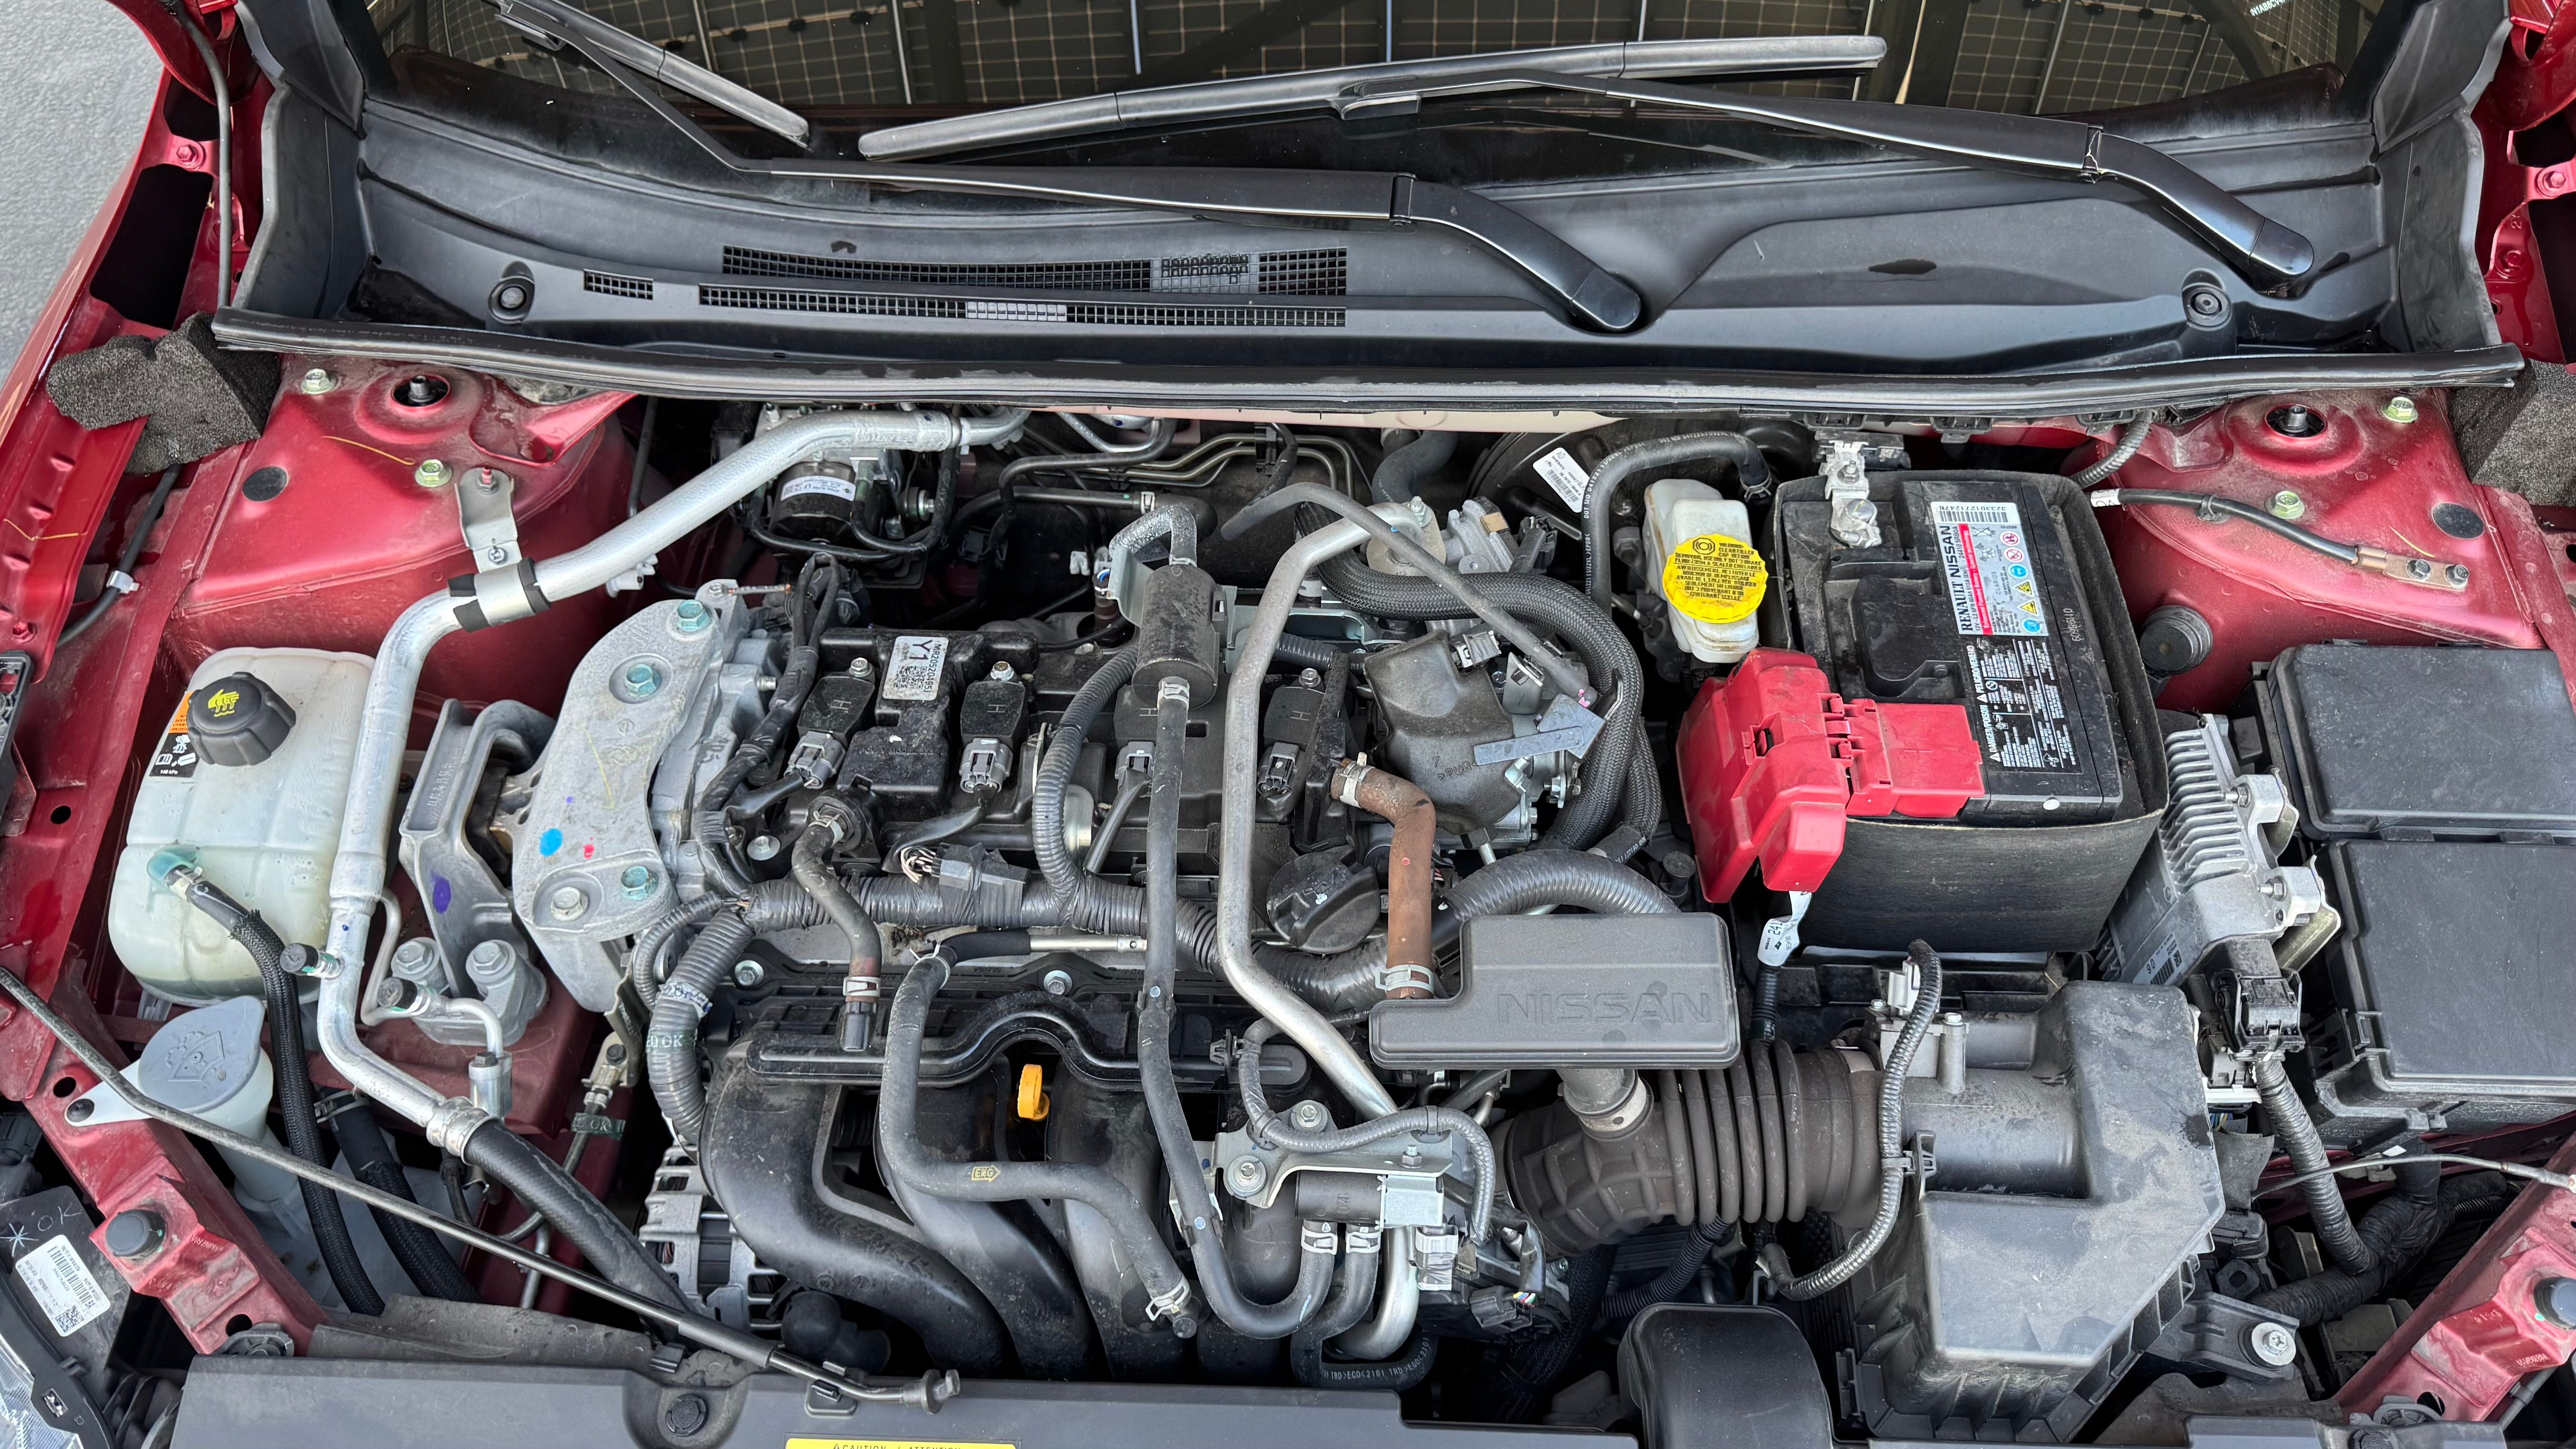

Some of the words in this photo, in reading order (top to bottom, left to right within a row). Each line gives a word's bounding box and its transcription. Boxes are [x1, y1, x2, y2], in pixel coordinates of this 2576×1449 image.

[1939, 525, 1961, 578] NISSAN
[1991, 571, 2001, 595] CLARIOS
[1951, 581, 1973, 631] RENAULT
[909, 639, 933, 660] Y1
[1966, 645, 1984, 693] PELIGRO/VENENO
[1979, 704, 1997, 753] DANGER/POISON
[1497, 992, 1711, 1025] NISSAN
[662, 1035, 684, 1048] OK
[591, 1119, 608, 1132] OK
[975, 1168, 994, 1178] ENG
